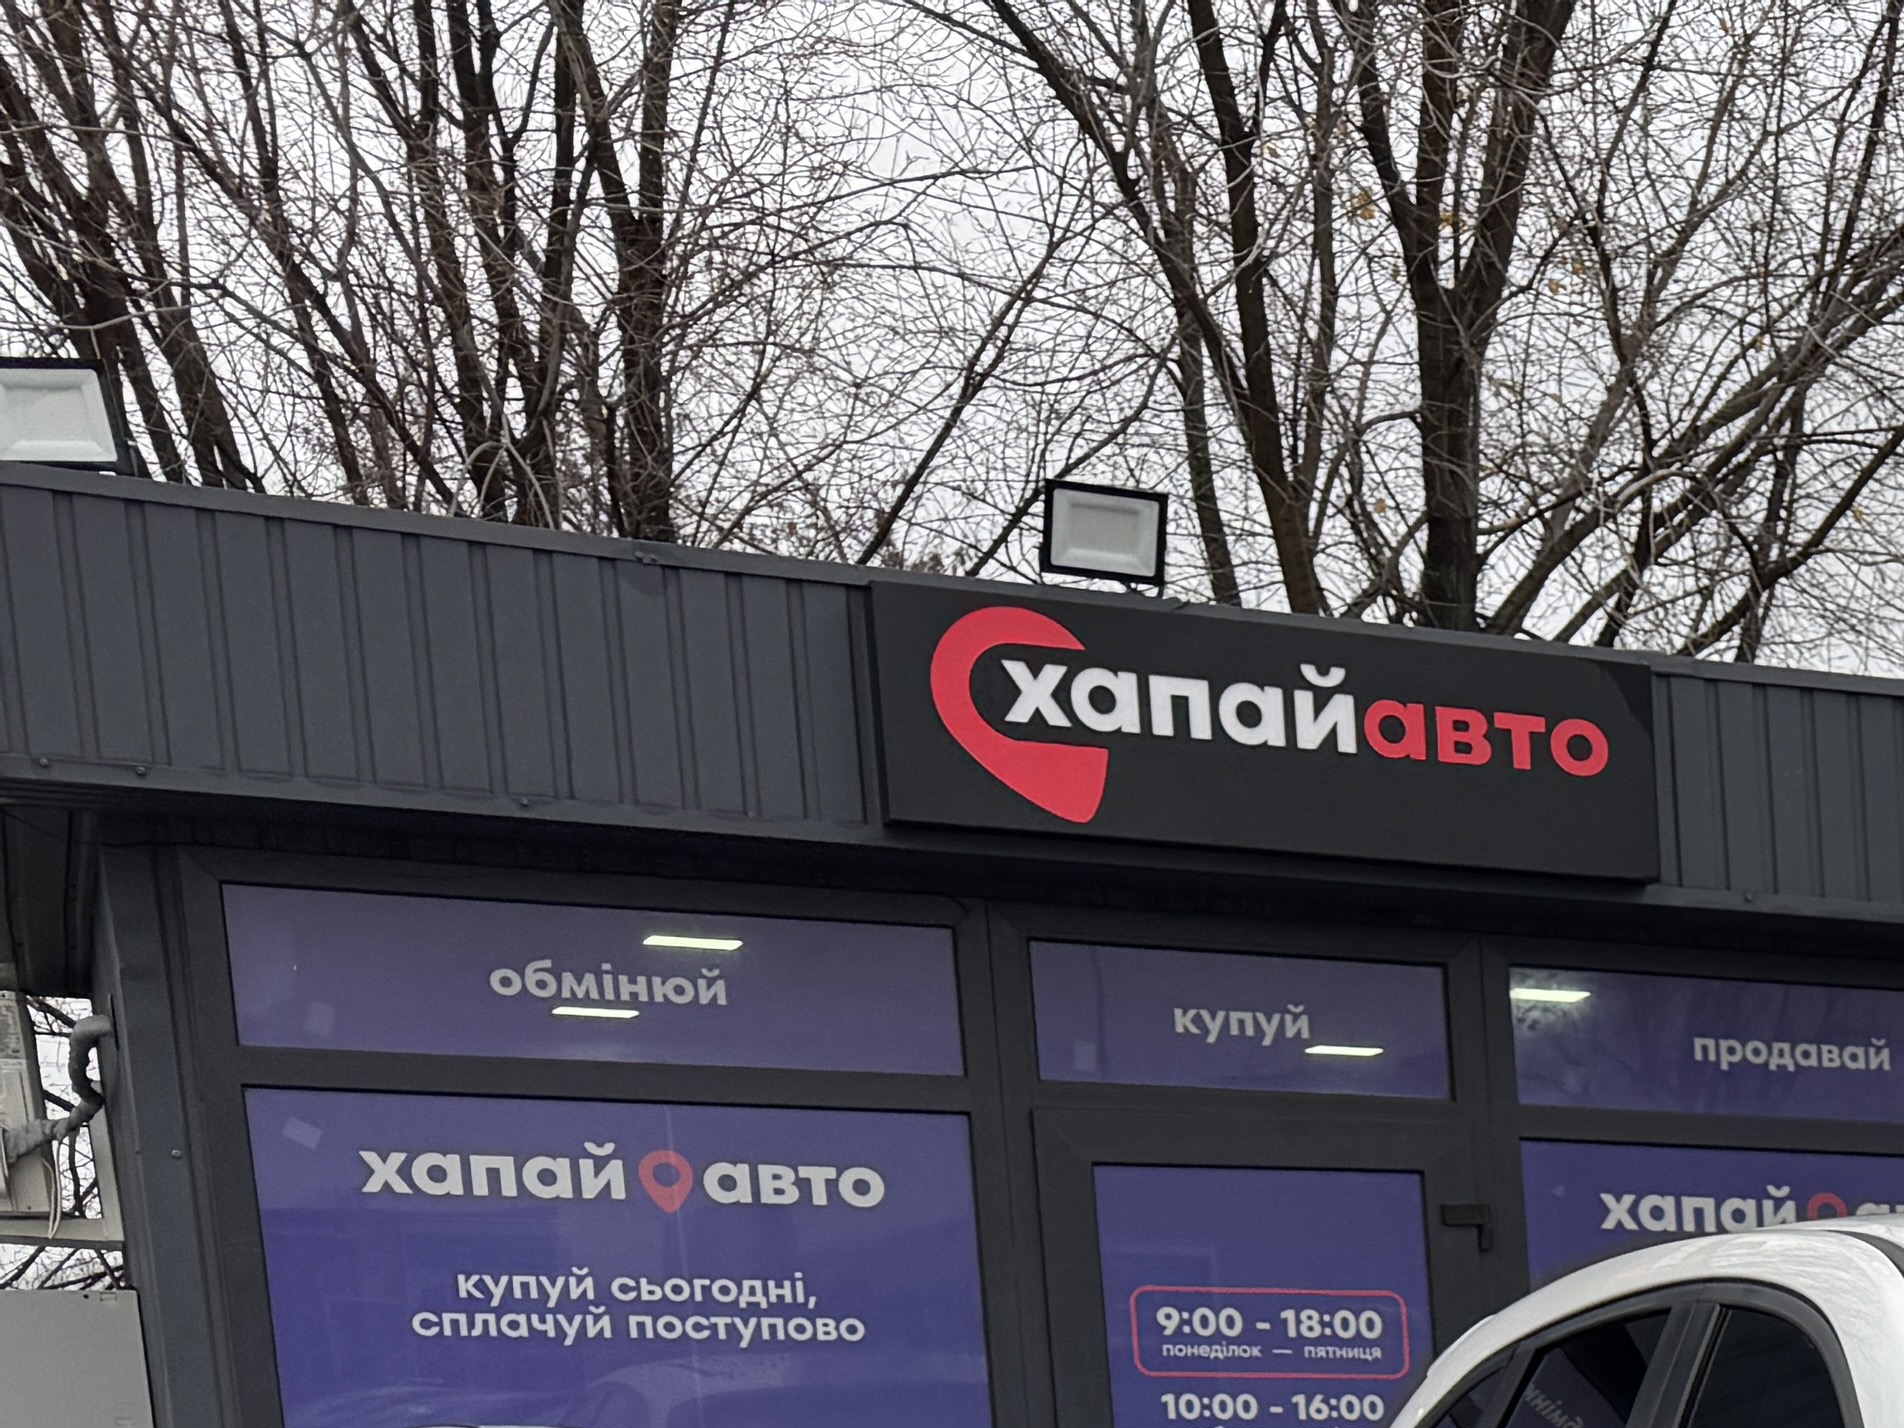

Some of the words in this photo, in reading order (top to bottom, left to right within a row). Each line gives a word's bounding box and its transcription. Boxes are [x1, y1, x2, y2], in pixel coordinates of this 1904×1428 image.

[489, 958, 728, 1006] обмінюй
[1173, 1004, 1311, 1046] купуй
[1693, 1037, 1891, 1072] продавай
[358, 1141, 627, 1200] хапай
[702, 1158, 886, 1208] авто
[1599, 1185, 1796, 1233] хапай
[456, 1266, 595, 1308] купуй
[610, 1271, 817, 1310] сьогодні,
[411, 1305, 613, 1346] сплачуй
[628, 1314, 866, 1349] поступово
[1156, 1306, 1243, 1337] 9:00
[1280, 1308, 1383, 1340] 18:00
[1162, 1341, 1263, 1359] понеділок
[1303, 1345, 1382, 1360] пятниця
[1160, 1393, 1259, 1421] 10:00
[1291, 1394, 1385, 1421] 16:00
